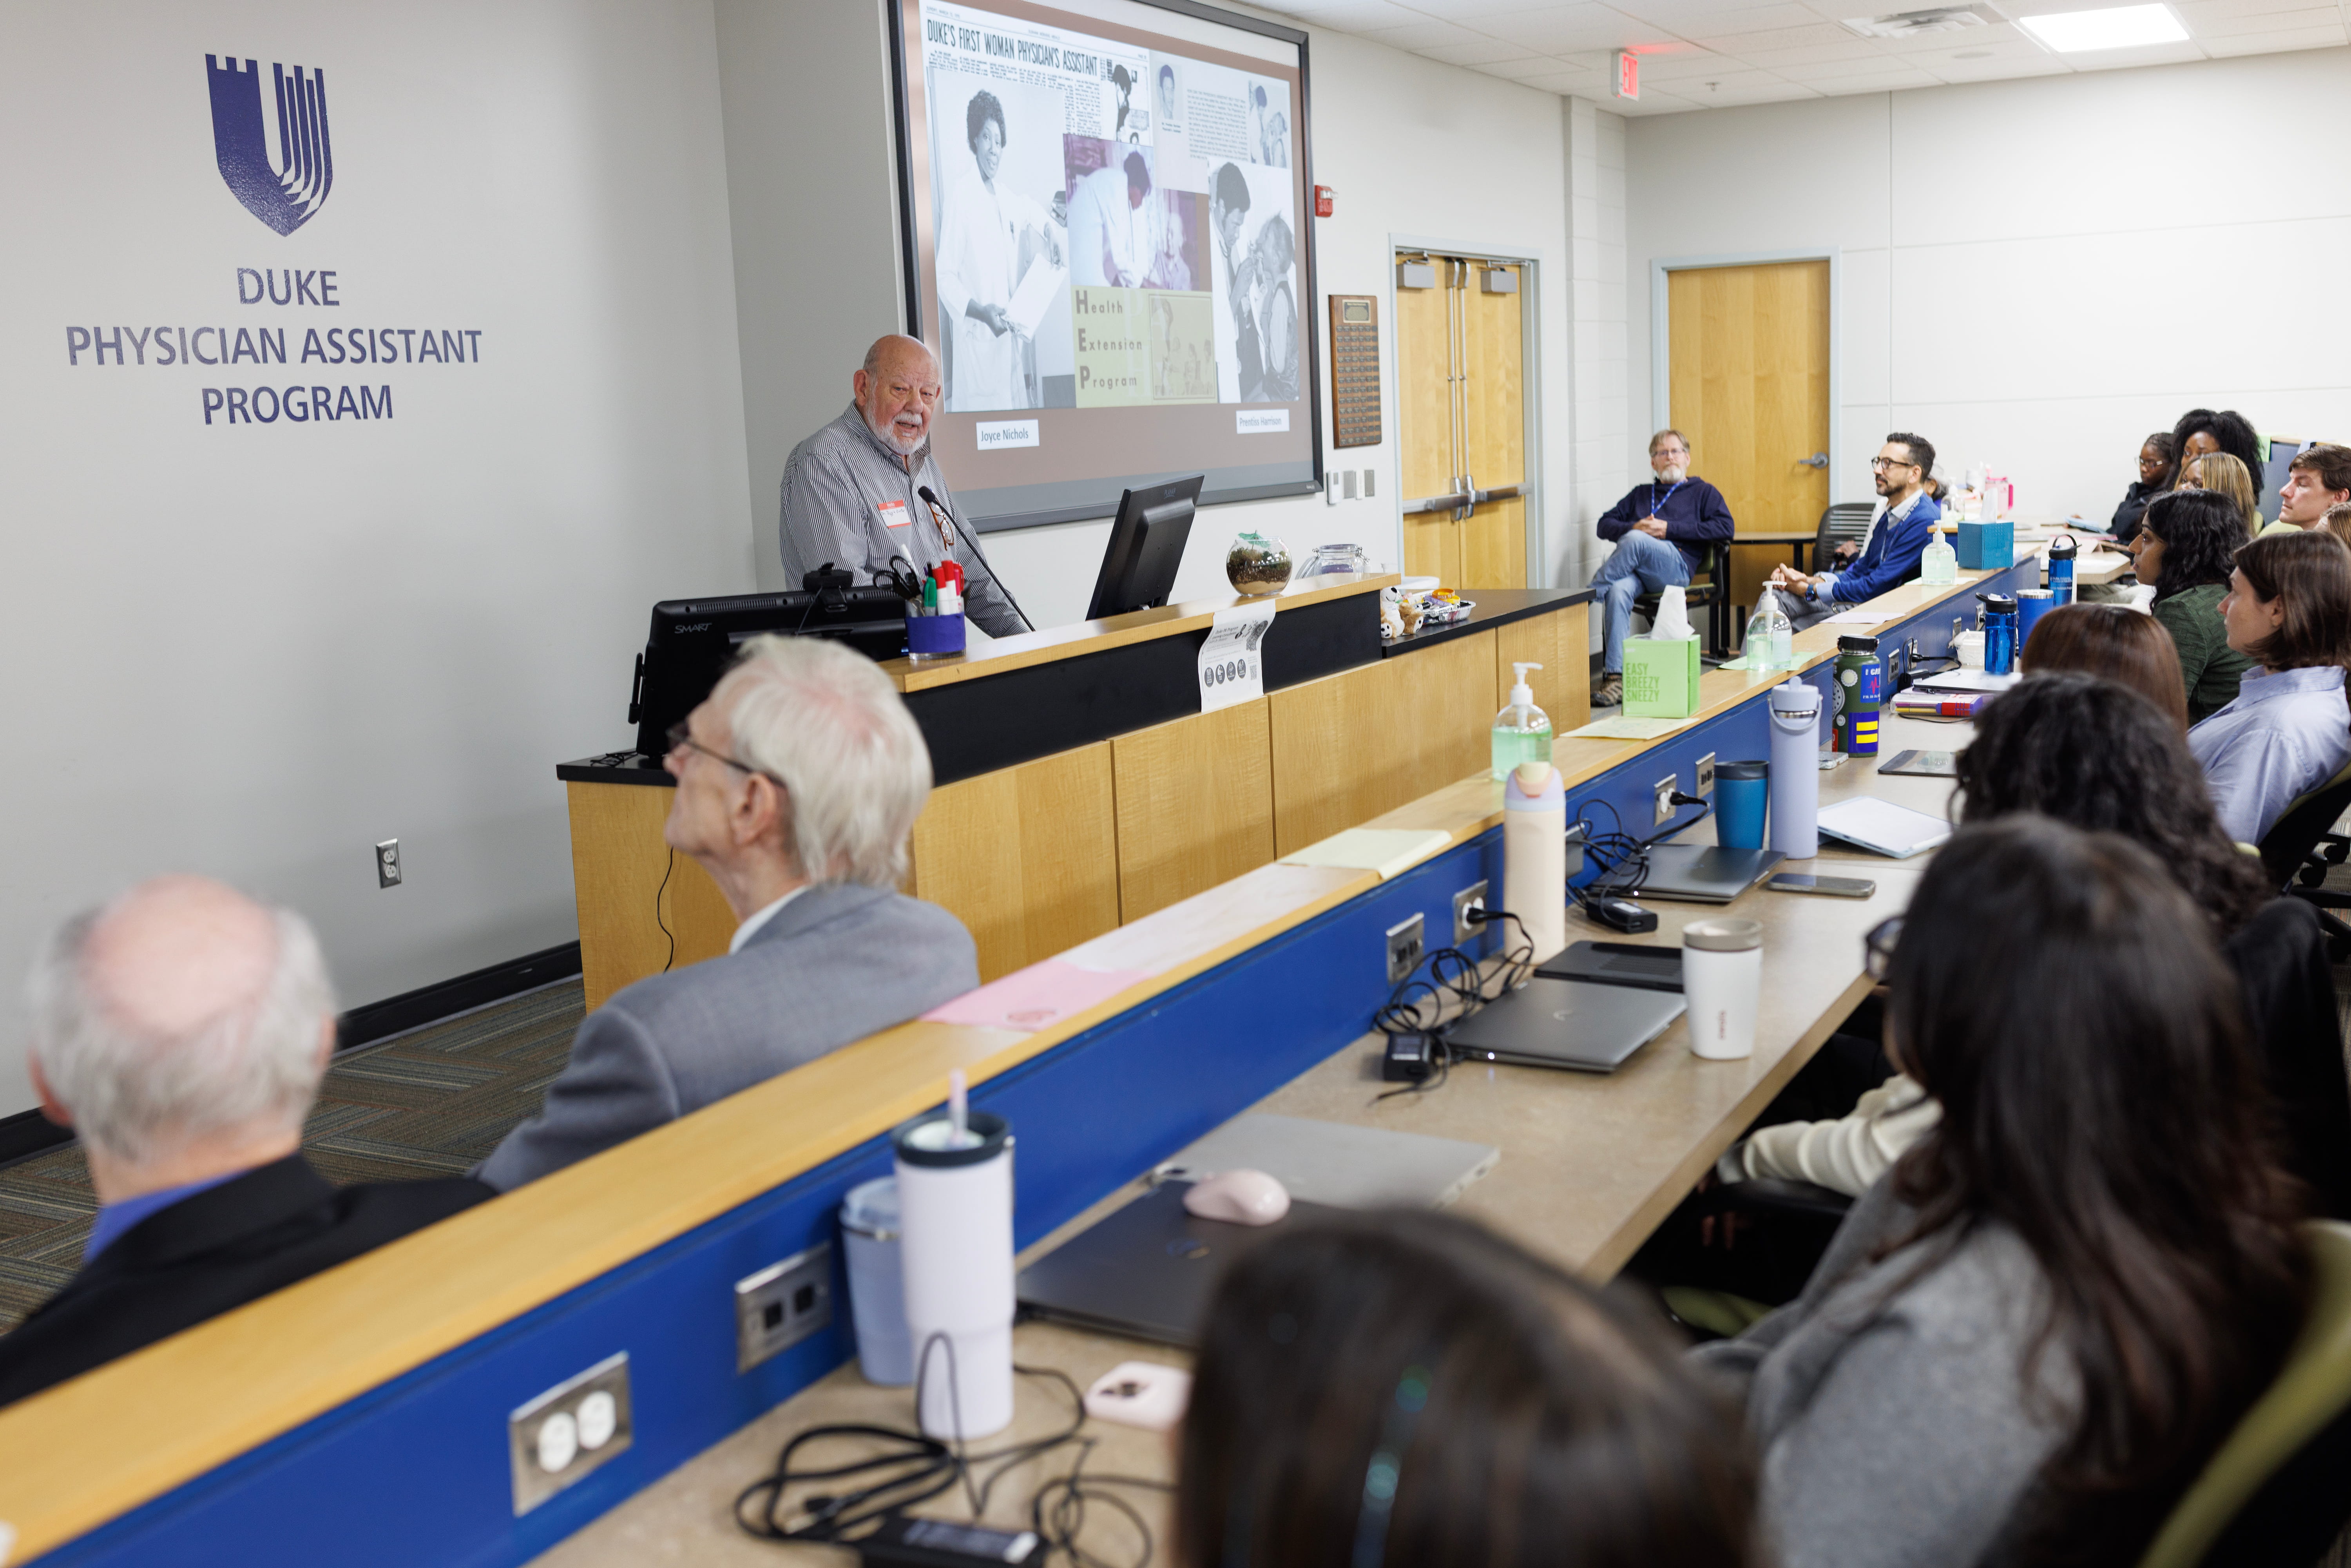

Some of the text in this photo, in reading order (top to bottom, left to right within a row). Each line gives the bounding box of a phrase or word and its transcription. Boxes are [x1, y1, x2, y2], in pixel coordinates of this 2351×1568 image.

[927, 19, 955, 47] DUKE'S
[959, 27, 980, 53] FIRST
[984, 33, 1014, 60] WOMAN
[1018, 40, 1060, 69] PHYSICIAN'S
[1063, 50, 1097, 76] ASSISTANT
[237, 268, 340, 306] DUKE
[1076, 290, 1123, 314] Health
[66, 326, 482, 366] PHYSICIAN ASSISTANT
[1078, 328, 1142, 351] Extension
[1080, 366, 1137, 389] Program
[201, 385, 393, 425] PROGRAM
[1239, 416, 1282, 426] Prentiss Harrison
[981, 427, 1029, 444] Joyce Nichols
[675, 623, 713, 634] SMART
[1627, 663, 1648, 675] EASY
[1627, 676, 1660, 689] BREEZY
[1627, 690, 1660, 702] SNEEZY
